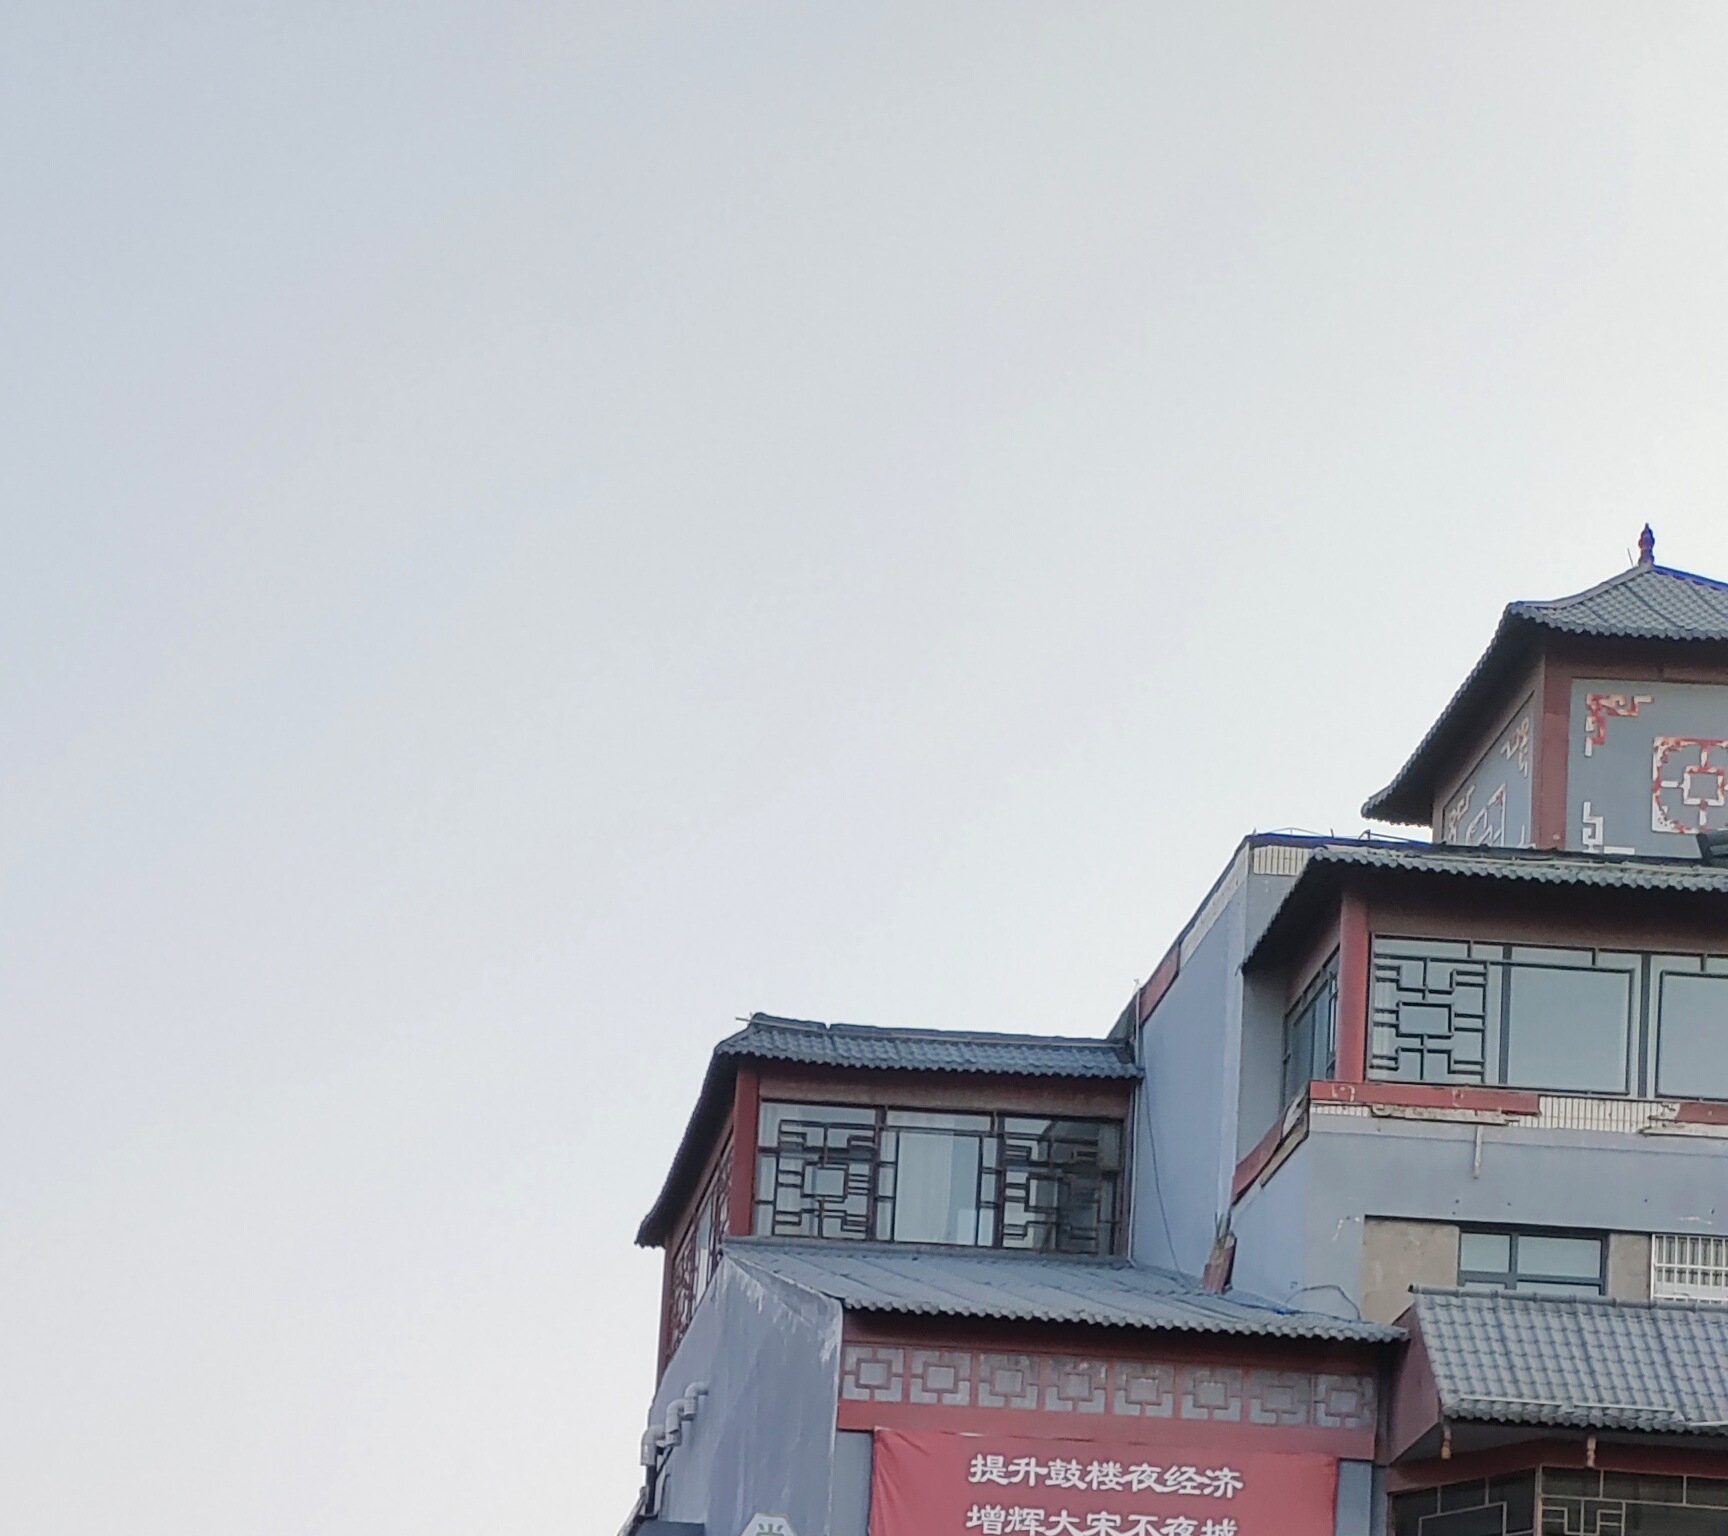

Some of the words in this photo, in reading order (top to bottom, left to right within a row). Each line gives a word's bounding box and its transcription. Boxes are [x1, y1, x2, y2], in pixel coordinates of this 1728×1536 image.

[968, 1454, 1243, 1499] 提升鼓楼夜经济
